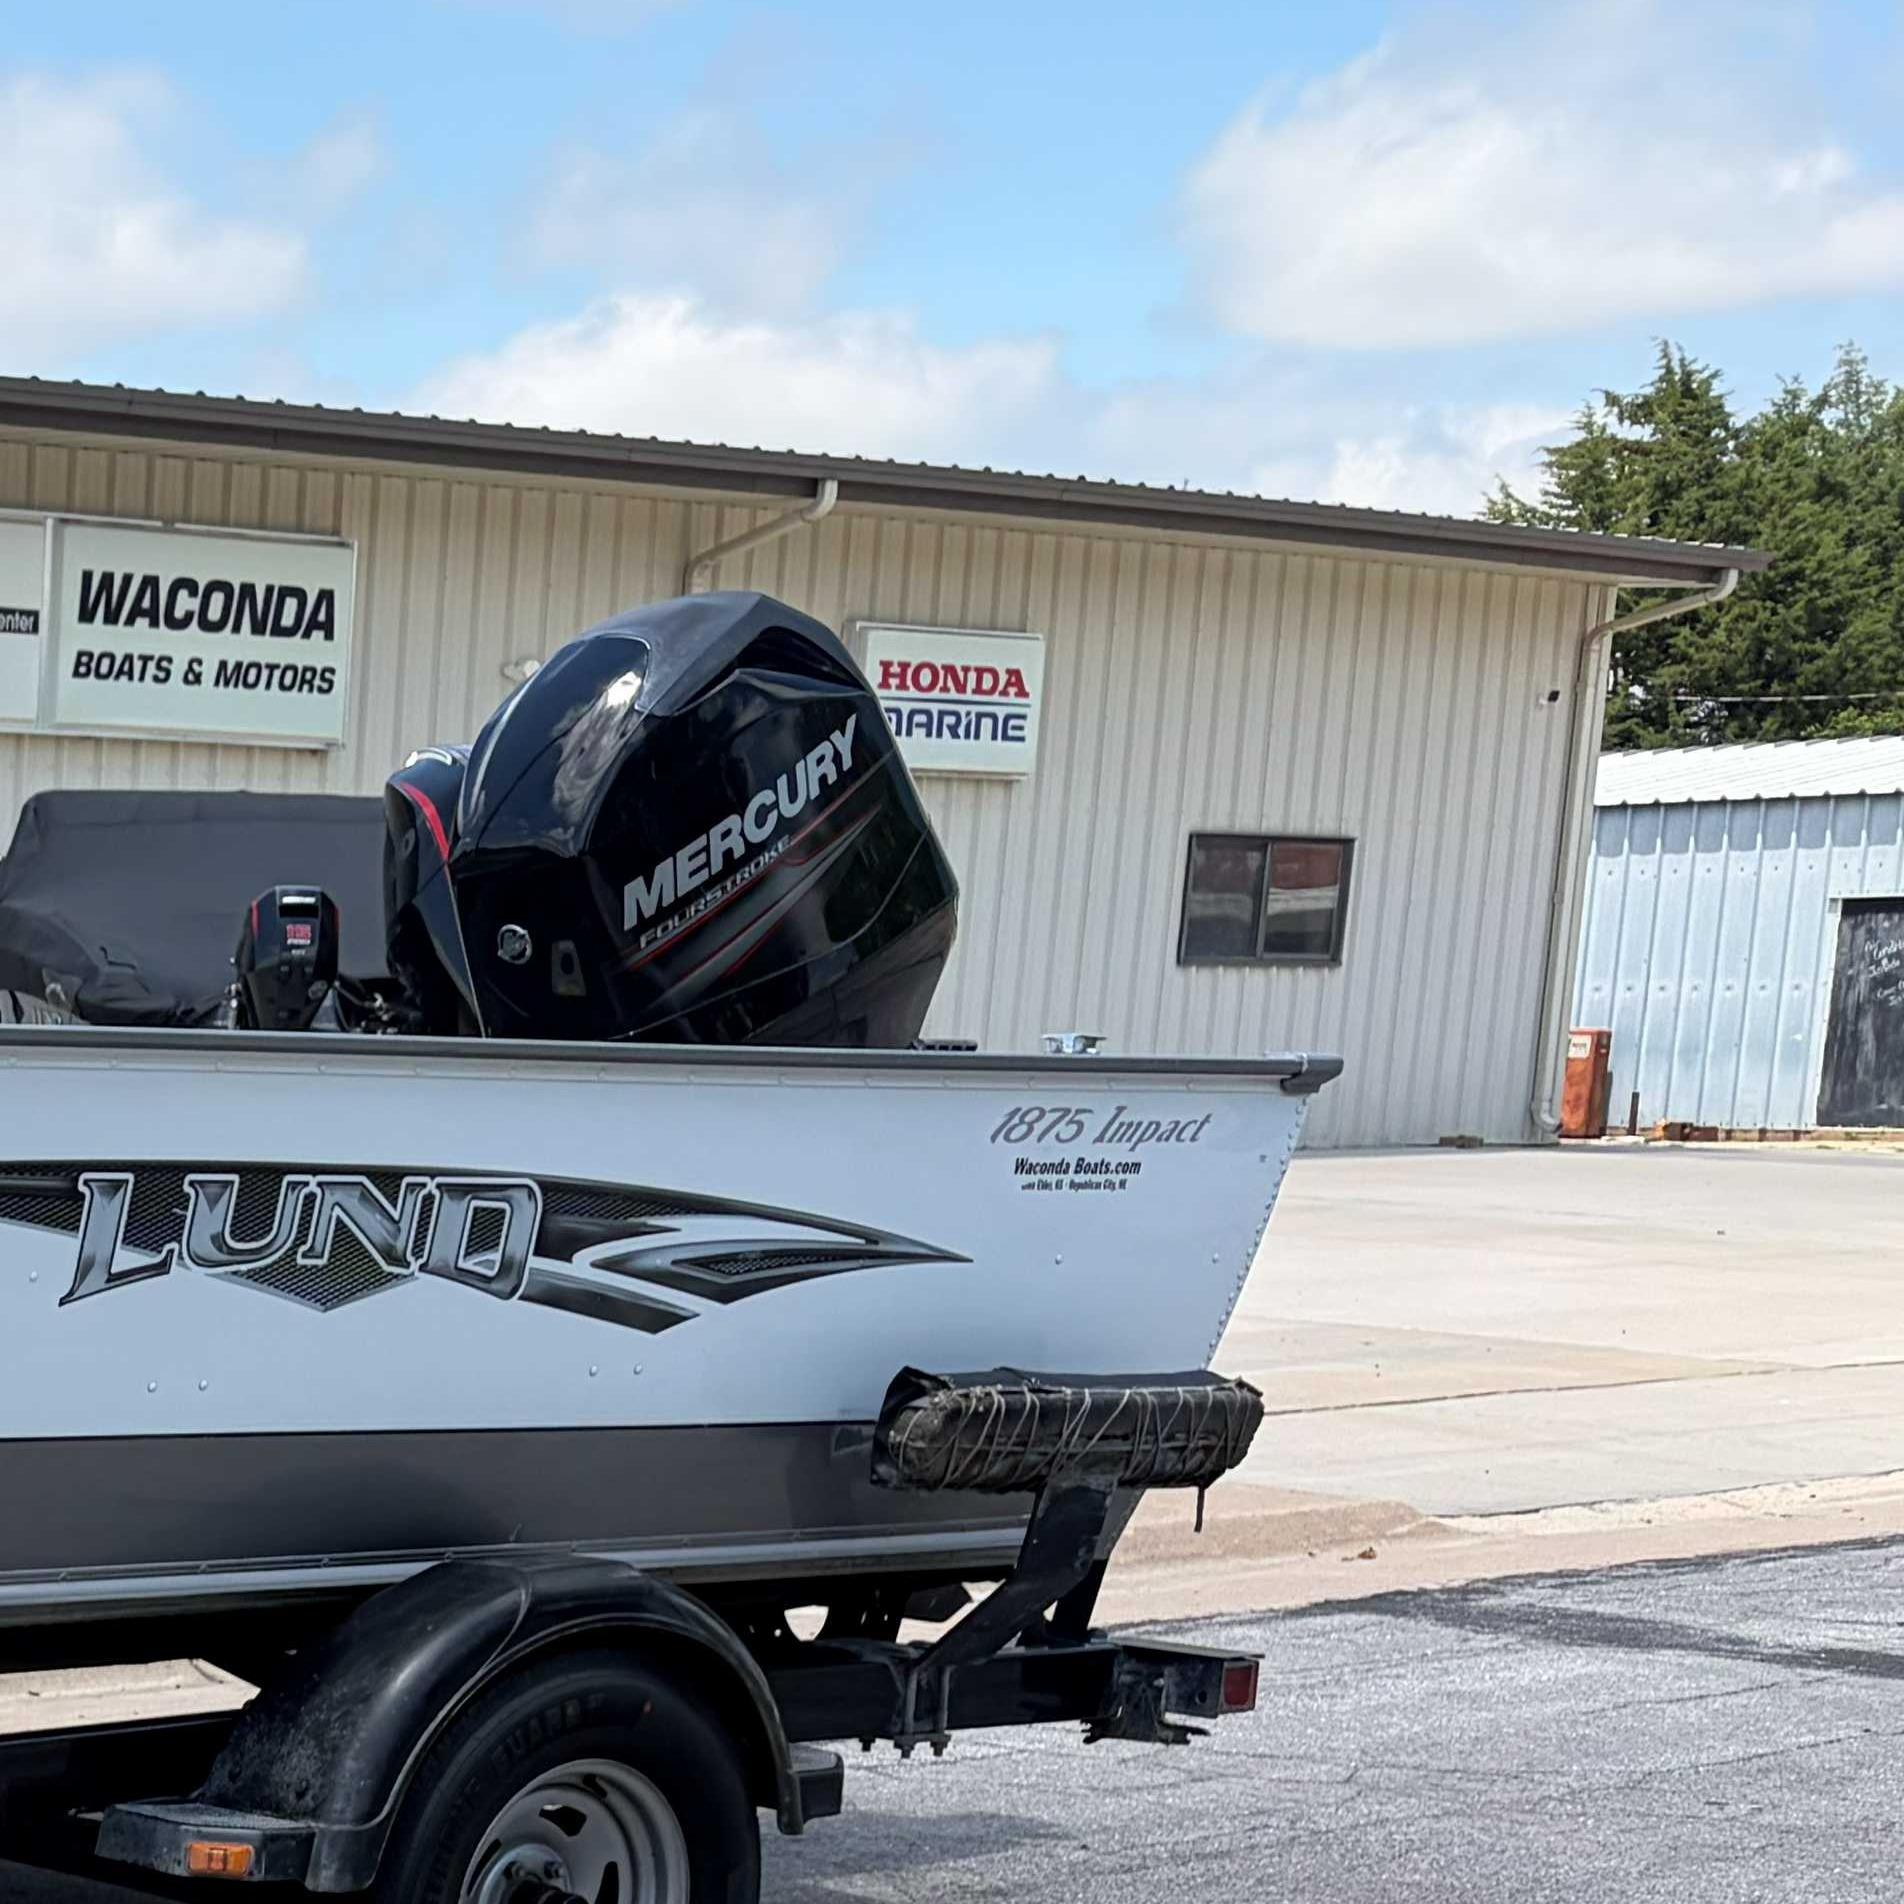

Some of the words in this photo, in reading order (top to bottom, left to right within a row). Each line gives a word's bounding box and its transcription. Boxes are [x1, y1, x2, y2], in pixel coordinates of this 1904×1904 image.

[77, 569, 335, 641] WACONDA
[71, 649, 173, 685] BOATS
[182, 657, 204, 687] &
[213, 658, 337, 695] MOTORS
[877, 659, 1030, 699] HONDA
[623, 713, 858, 932] MERCURY
[639, 834, 792, 949] FOURSTROKE
[989, 1106, 1095, 1145] 1875
[1093, 1105, 1214, 1152] Impact
[1013, 1156, 1071, 1176] Waconda
[1073, 1156, 1143, 1176] Boats.com
[58, 1171, 542, 1308] LUND
